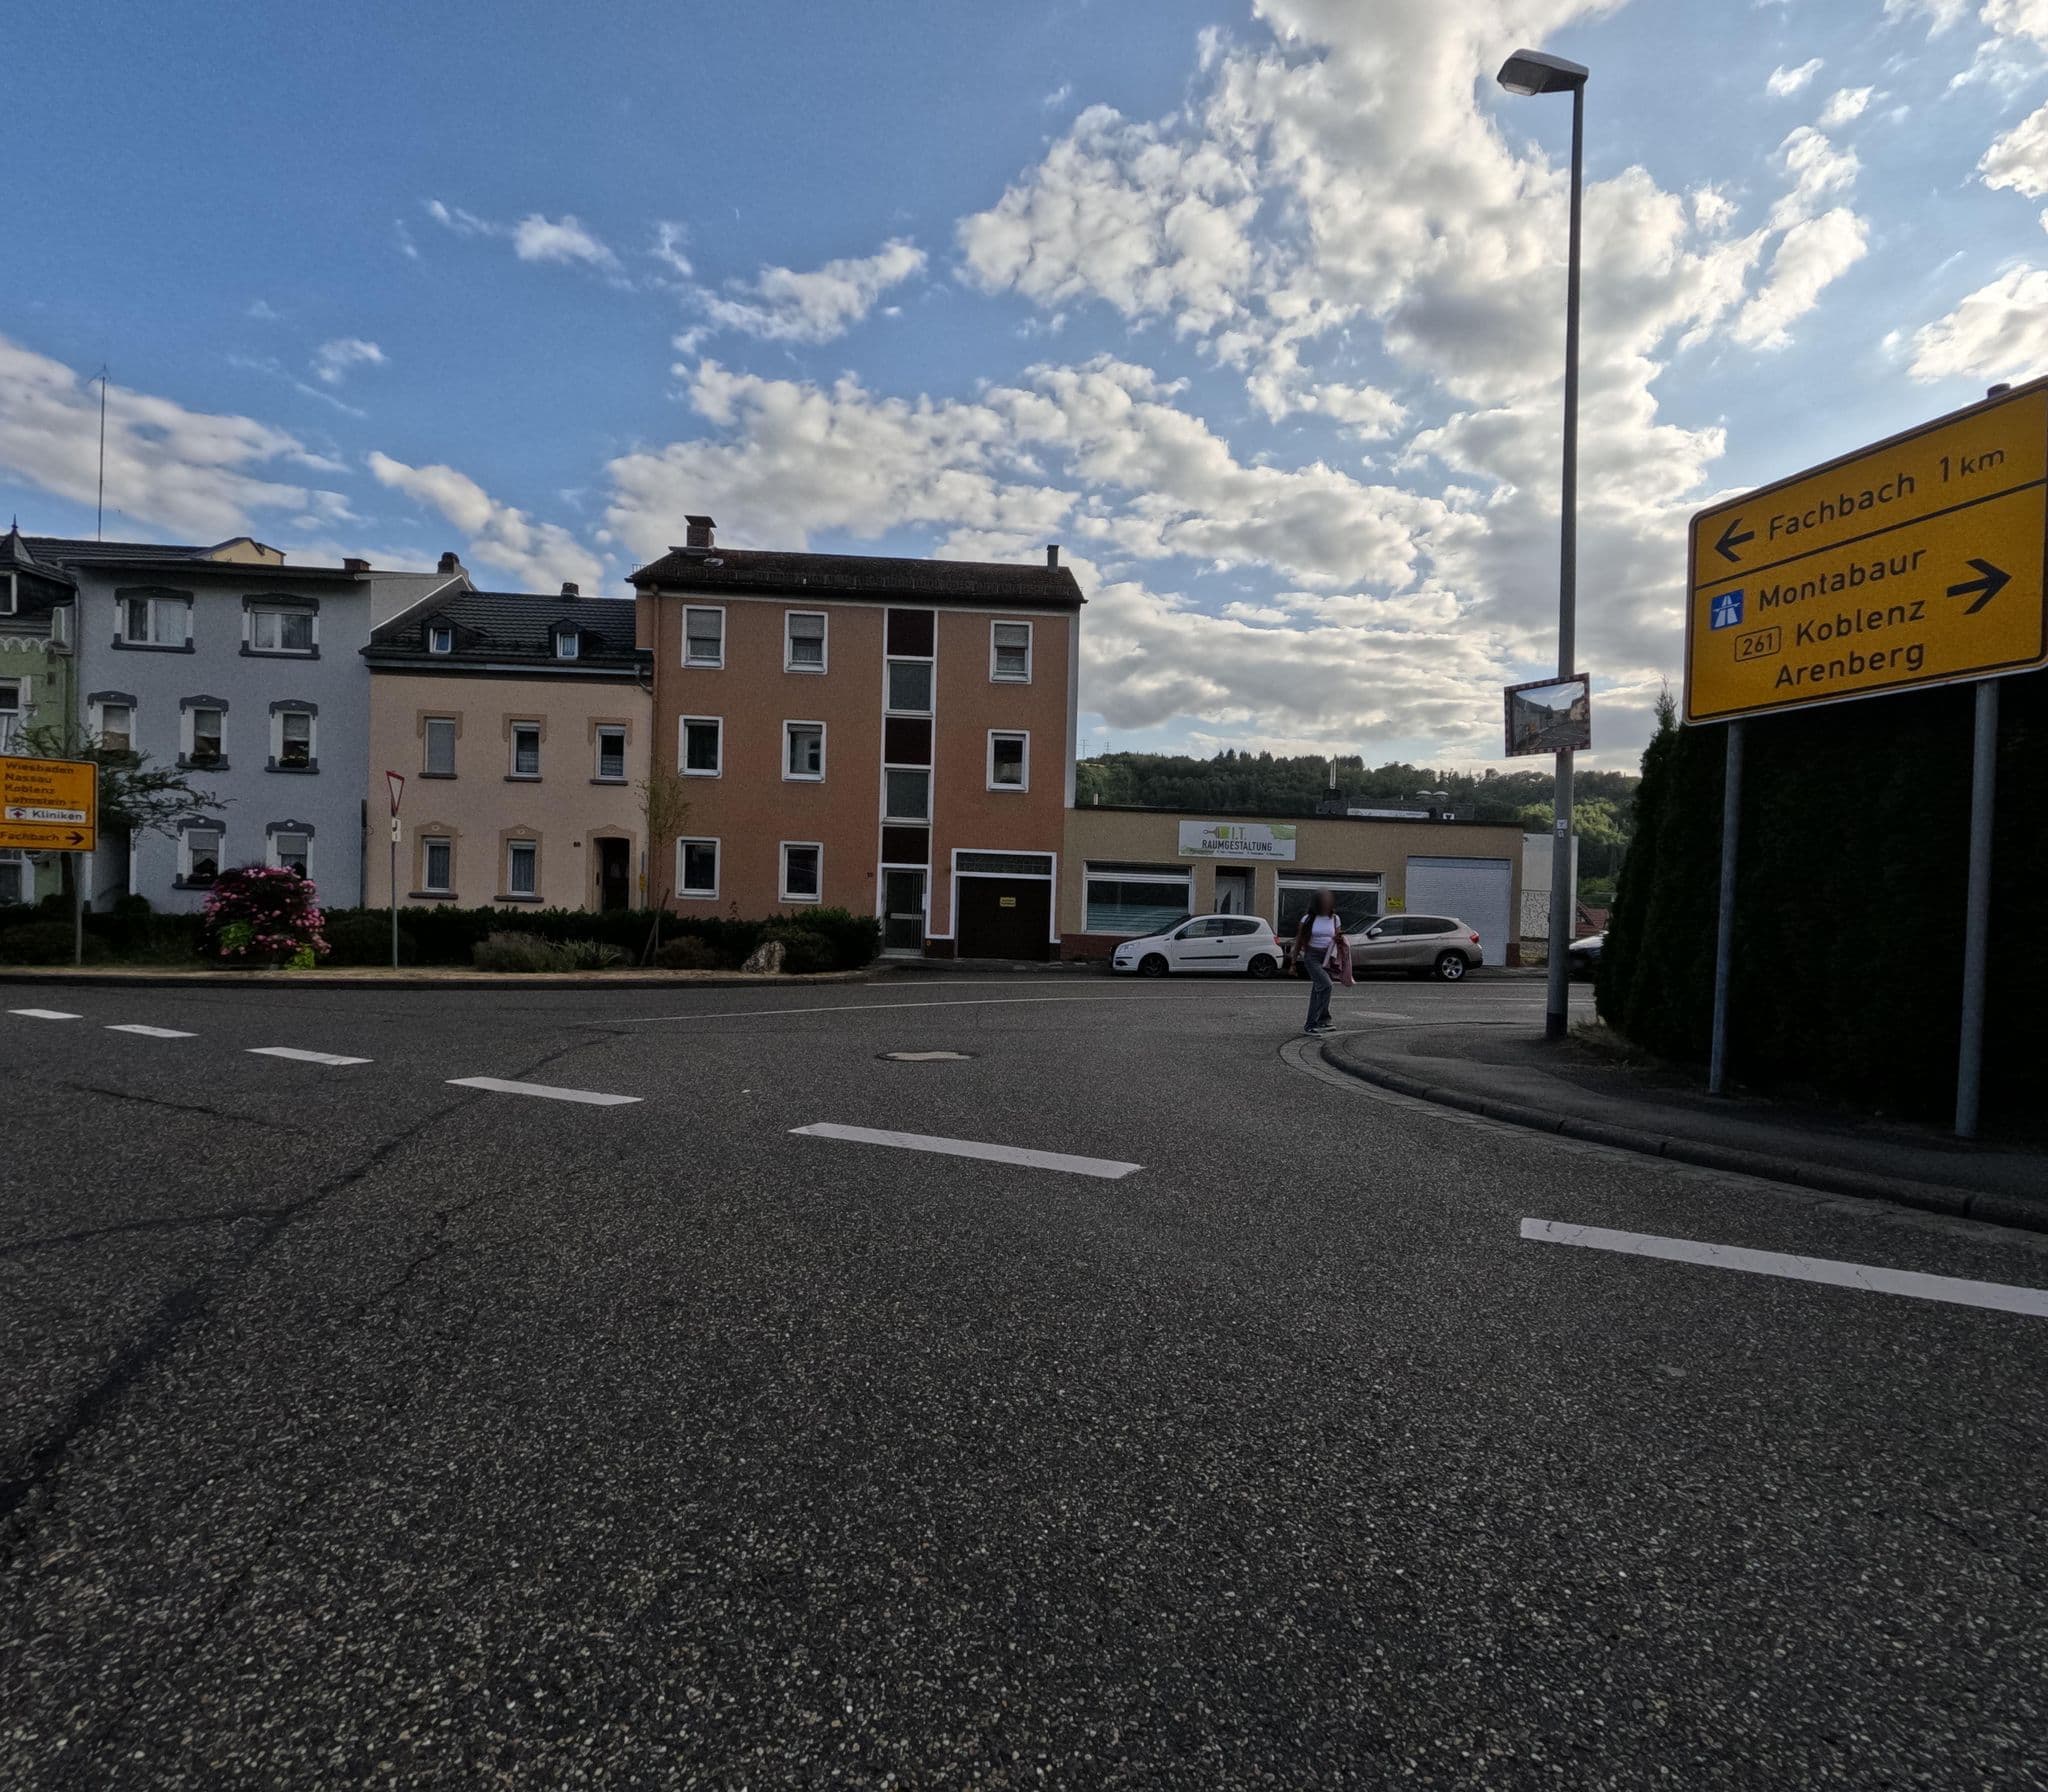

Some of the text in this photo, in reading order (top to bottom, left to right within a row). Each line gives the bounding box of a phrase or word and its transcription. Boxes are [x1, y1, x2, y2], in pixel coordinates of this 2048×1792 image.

[1769, 449, 2005, 541] Fachbach 1 km
[1759, 550, 1927, 611] Montabaur
[1742, 600, 1926, 656] 261 Koblenz
[1775, 642, 1924, 688] Arenberg
[6, 762, 74, 774] Wiesbaden
[5, 773, 52, 783] Nassau
[5, 784, 56, 794] Koblenz
[32, 810, 82, 820] Kliniken
[1, 831, 60, 841] Fachbach
[1202, 839, 1273, 852] RAUMGESTALTUNG
